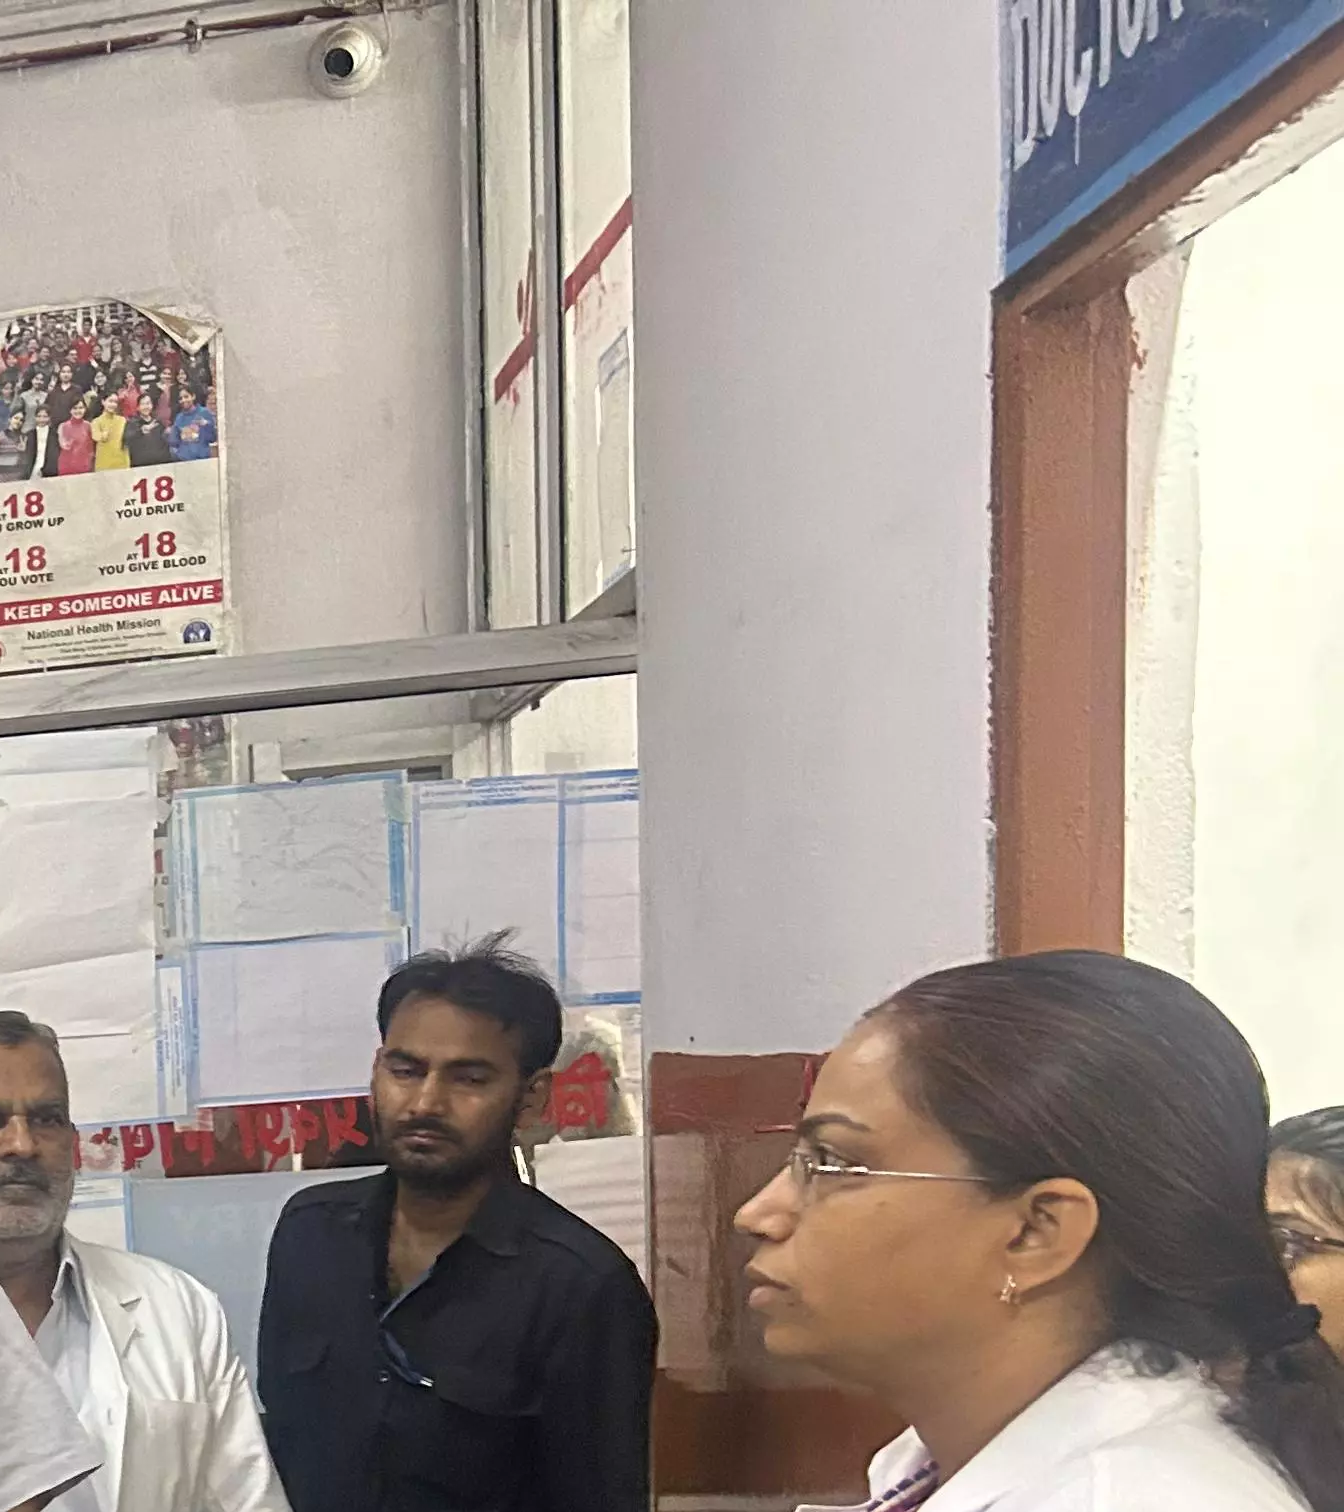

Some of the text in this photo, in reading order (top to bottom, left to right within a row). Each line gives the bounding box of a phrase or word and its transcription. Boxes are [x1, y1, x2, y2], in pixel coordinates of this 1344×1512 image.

[132, 475, 175, 504] 18
[3, 491, 45, 519] 18
[115, 502, 185, 519] YOU DRIVE
[6, 519, 44, 532] GROW
[48, 516, 65, 528] UP
[134, 531, 177, 559] 18
[5, 545, 47, 573] 18
[98, 555, 207, 577] YOU GIVE BLOOD
[22, 572, 55, 585] VOTE
[4, 602, 53, 621] KEEP
[58, 591, 153, 615] SOMEONE
[158, 584, 215, 604] ALIVE
[27, 626, 73, 641] National
[76, 619, 113, 636] Health
[116, 617, 161, 634] Mission
